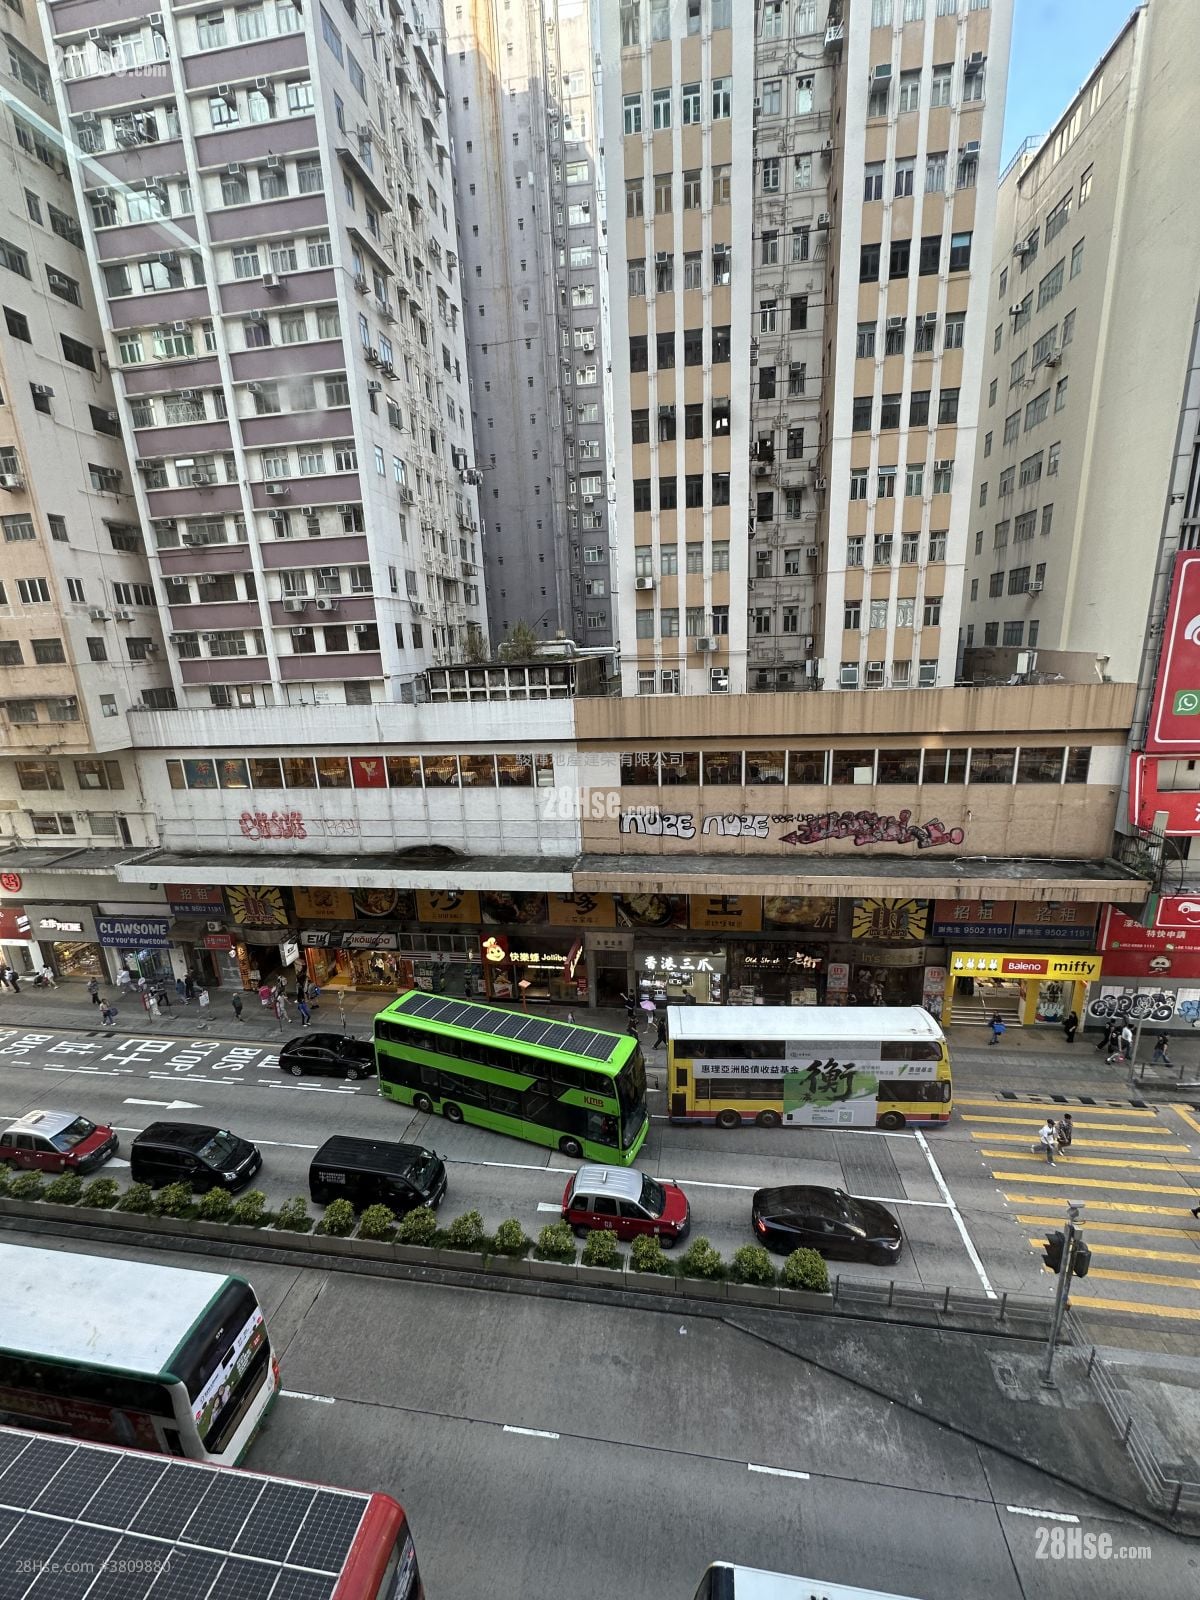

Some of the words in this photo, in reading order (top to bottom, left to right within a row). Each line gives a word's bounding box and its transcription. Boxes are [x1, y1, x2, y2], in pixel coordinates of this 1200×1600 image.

[954, 905, 993, 920] 招租
[1036, 907, 1078, 922] 招租
[99, 922, 167, 935] CLAWSOME
[963, 926, 985, 935] 9502
[988, 927, 1007, 936] 1191
[1045, 929, 1067, 937] 9502
[1146, 929, 1187, 939] 特快申請
[1008, 962, 1041, 971] Baleno
[1053, 961, 1095, 975] miffy
[100, 1038, 177, 1066] 巴士
[164, 1041, 220, 1072] STOP
[211, 1047, 263, 1071] BUS
